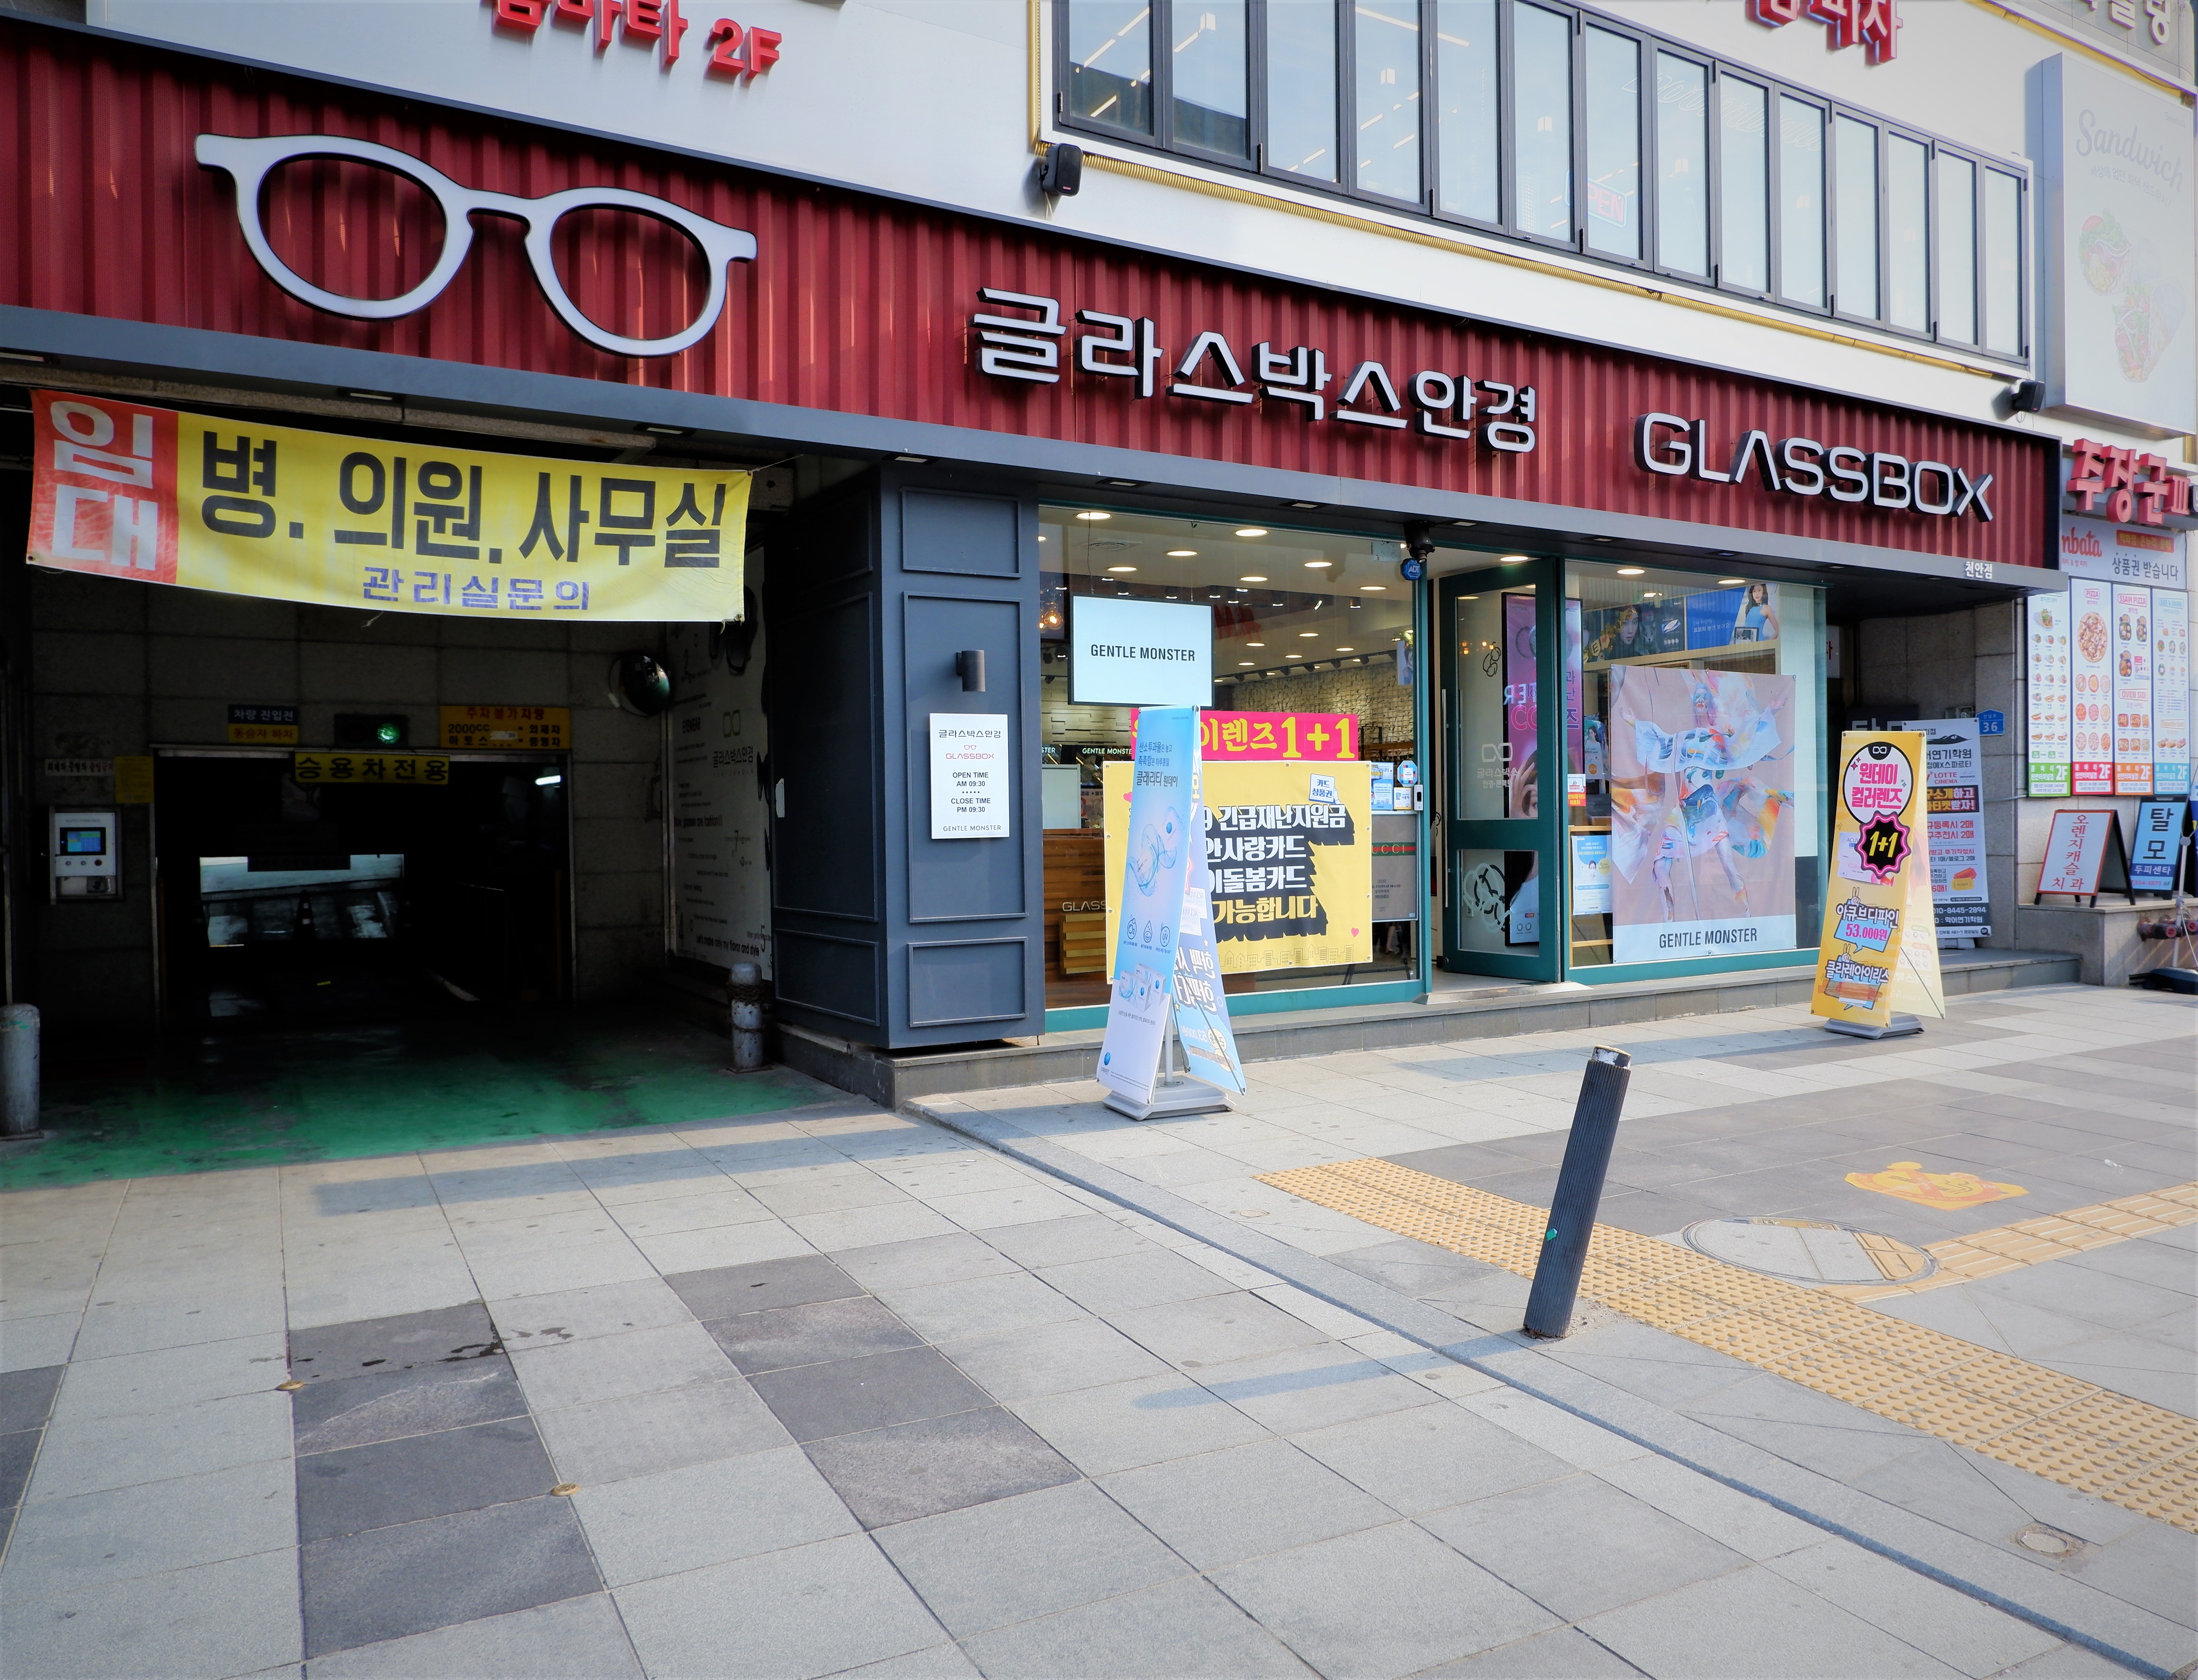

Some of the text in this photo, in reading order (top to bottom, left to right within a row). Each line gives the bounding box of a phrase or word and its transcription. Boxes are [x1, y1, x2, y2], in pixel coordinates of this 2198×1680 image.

[707, 18, 782, 79] 2F
[2076, 109, 2183, 193] Sandwich
[1587, 183, 1624, 222] PEN
[970, 286, 1536, 454] 글라스박스안경
[1634, 411, 1994, 522] GLASSBOX
[51, 399, 158, 573] 임대
[519, 472, 729, 570] 사무실
[1964, 561, 1993, 580] 천안점
[2112, 557, 2179, 582] 상품권 받습니다
[363, 565, 590, 612] 관리실문의
[2119, 595, 2146, 605] SSAM PIZZA
[1091, 644, 1196, 662] GENTLE MONSTER
[234, 709, 293, 722] 차량 진입전
[682, 717, 701, 734] EYEWEAR
[234, 728, 293, 740] 동승자 하차
[939, 730, 1001, 738] 글라스박스안경
[1982, 721, 1998, 732] 36
[1139, 741, 1164, 753] 산소투과율은
[1281, 717, 1355, 759] 1+1
[713, 745, 753, 768] 글라스박스안경
[1138, 756, 1170, 766] 촉촉함은 하루종일
[296, 757, 447, 782] 승용차전용
[1136, 771, 1178, 788] 클래리티 원데이
[1859, 763, 1898, 785] 원데이
[2056, 765, 2068, 780] 2F
[2099, 764, 2111, 779] 2F
[2140, 765, 2151, 780] 2F
[2177, 765, 2187, 780] 2F
[1312, 787, 1333, 798] 상품권
[1316, 779, 1330, 788] 카드
[1851, 787, 1903, 809] 컬러렌즈
[1218, 804, 1346, 831] 긴급재난지원금
[1869, 831, 1898, 858] 1+1
[2143, 808, 2174, 860] 탈모
[2063, 814, 2089, 876] 오렌지캐슬
[2134, 865, 2171, 875] 두피센타
[2051, 877, 2084, 891] 치과
[1212, 895, 1318, 924] 가능합니다
[1836, 904, 1899, 929] 아큐브디파인
[1659, 927, 1757, 948] GENTLE MONSTER
[1846, 923, 1888, 941] 53,000원
[723, 940, 729, 951] my
[730, 939, 740, 952] flavor
[750, 944, 760, 957] style
[1826, 960, 1889, 983] 클라렌아이리스
